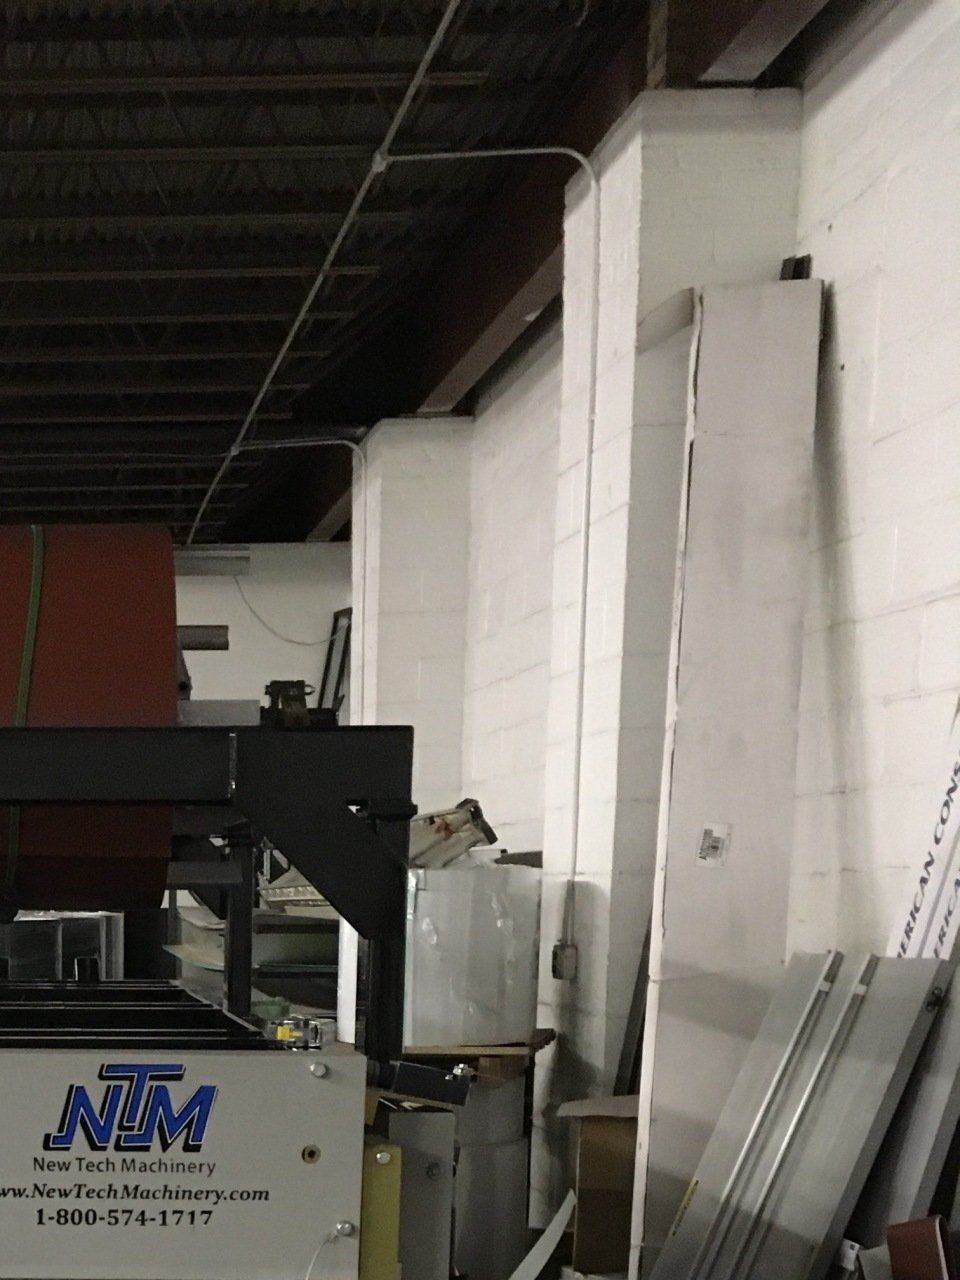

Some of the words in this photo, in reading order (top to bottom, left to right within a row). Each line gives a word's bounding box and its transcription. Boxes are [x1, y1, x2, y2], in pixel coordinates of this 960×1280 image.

[897, 851, 935, 957] ERICAN
[934, 748, 960, 845] CONS
[42, 1063, 219, 1152] NTM
[32, 1156, 71, 1173] New
[75, 1157, 116, 1173] Tech
[121, 1157, 217, 1178] Machinery
[35, 1207, 214, 1227] 1-800-574-1717
